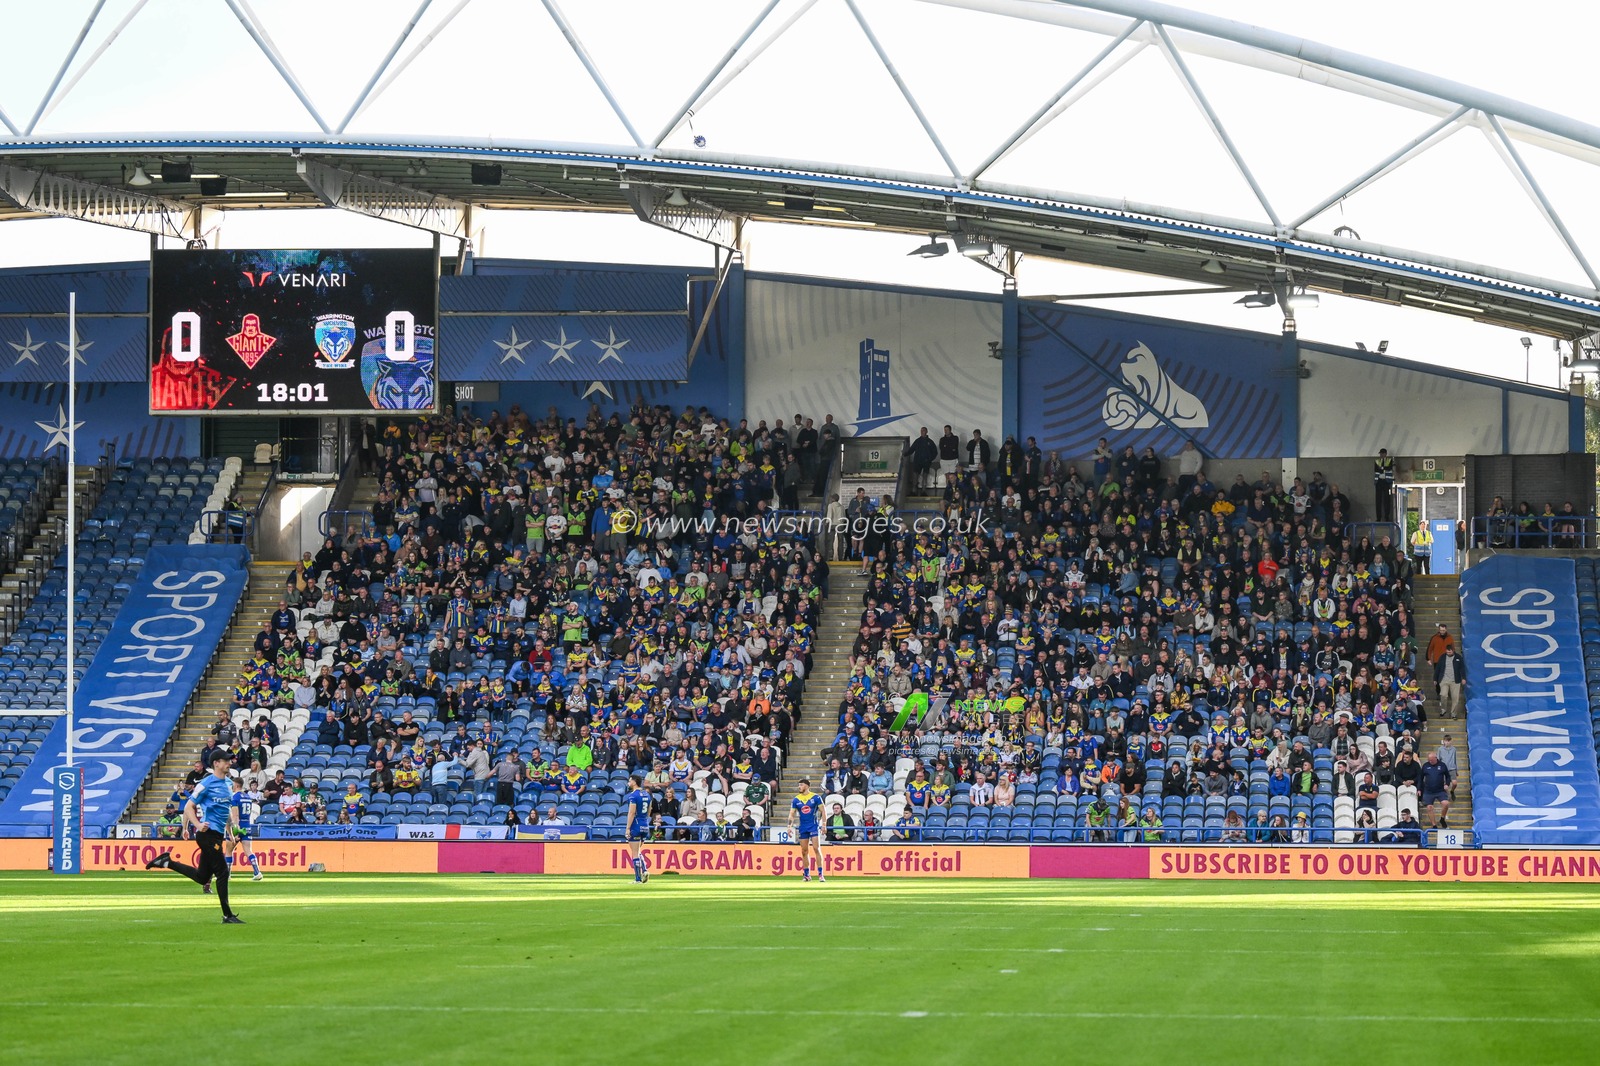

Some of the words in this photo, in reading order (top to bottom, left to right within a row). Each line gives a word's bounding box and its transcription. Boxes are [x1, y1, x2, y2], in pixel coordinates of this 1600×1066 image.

[279, 273, 346, 287] VENARI
[172, 312, 200, 361] 0
[232, 335, 269, 351] GIANTS
[386, 311, 414, 361] 0
[257, 383, 328, 401] 18:01
[455, 386, 474, 399] SHOT
[1425, 461, 1434, 469] 18
[1479, 586, 1578, 830] SPORTVISION
[241, 802, 251, 814] 13
[641, 802, 648, 813] 3
[61, 793, 72, 870] BETFRED
[328, 828, 352, 837] only
[409, 831, 435, 839] WA2
[777, 832, 788, 842] 19
[1445, 834, 1456, 845] 18
[612, 849, 762, 870] INSTAGRAM:
[1161, 853, 1291, 874] SUBSCRIBE
[1300, 854, 1329, 874] TO
[1338, 854, 1389, 875] OUR
[1398, 855, 1508, 876] YOUTUBE
